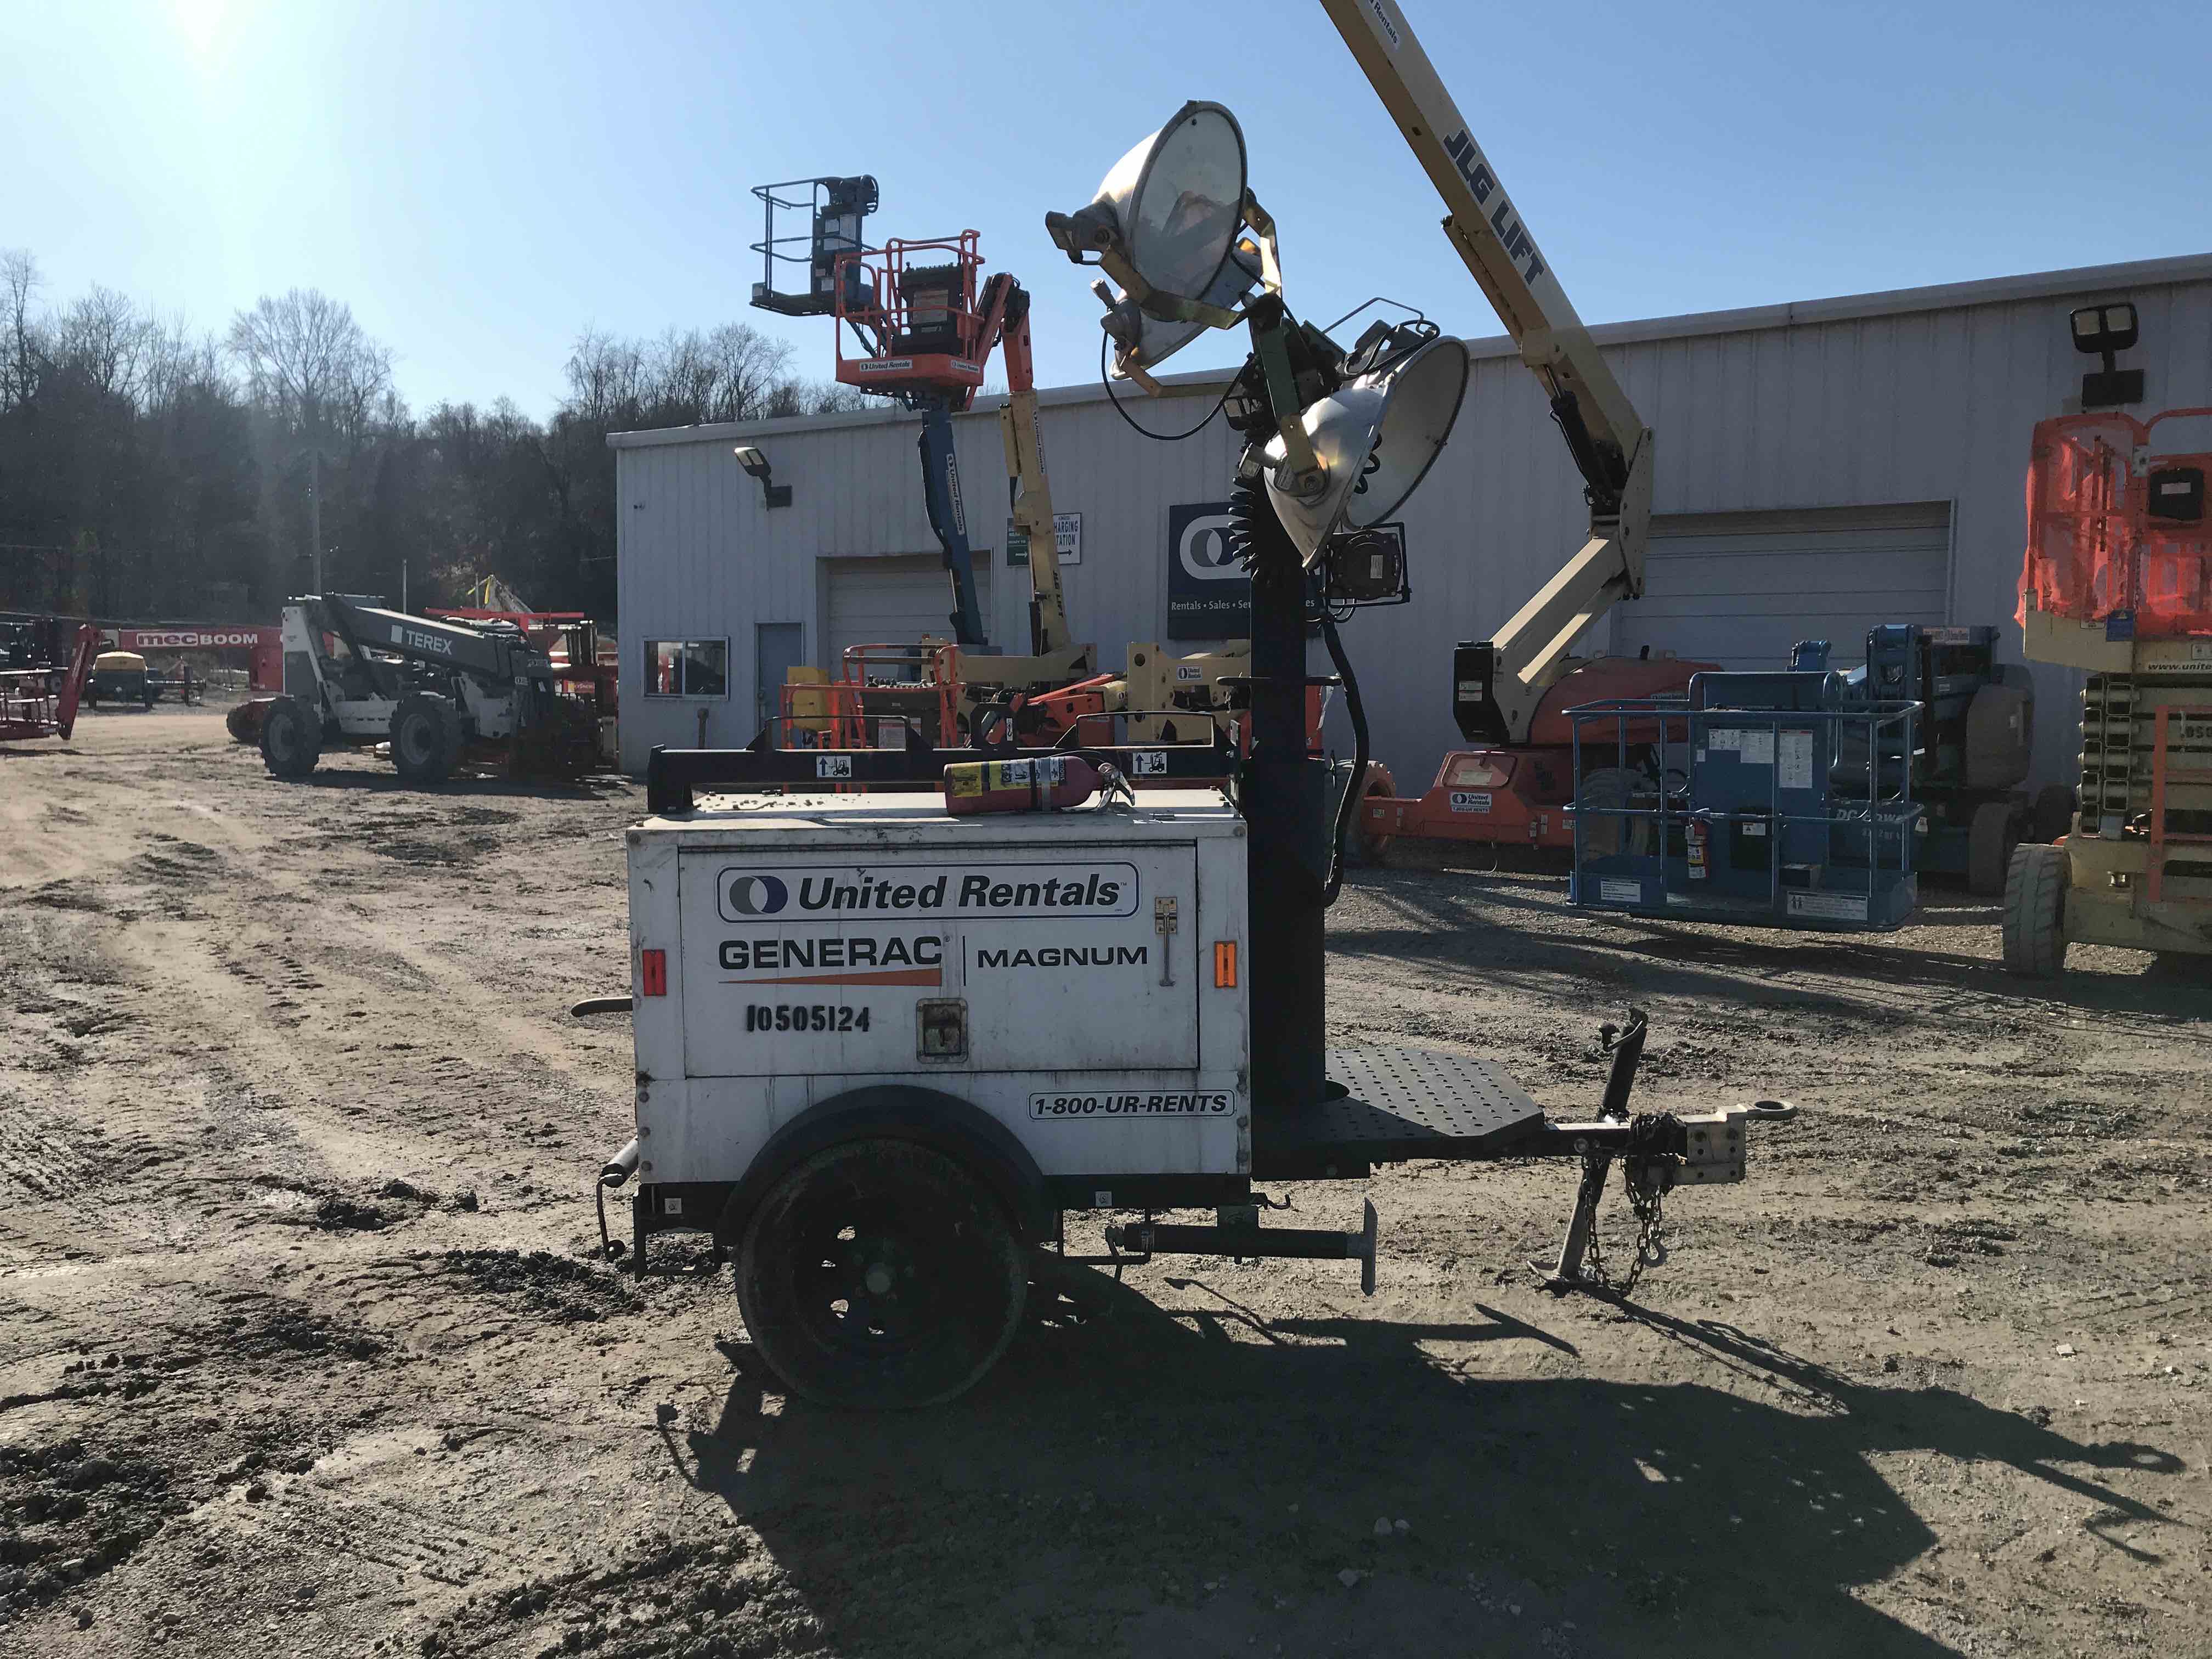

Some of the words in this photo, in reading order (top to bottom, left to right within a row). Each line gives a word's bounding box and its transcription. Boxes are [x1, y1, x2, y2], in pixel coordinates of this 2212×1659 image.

[1374, 2, 1397, 43] Rentals
[1443, 129, 1496, 205] JLG
[1491, 199, 1544, 285] LIFT
[1053, 521, 1079, 533] HARGING
[1056, 534, 1075, 546] TATION
[1171, 600, 1201, 610] Rentals
[1209, 600, 1230, 609] Sales
[407, 629, 453, 655] TEREX
[799, 877, 947, 910] United
[958, 874, 1120, 908] Rentals
[719, 936, 943, 970] GENERAC
[978, 947, 1148, 969] MAGNUM
[746, 1005, 871, 1033] 10505124
[1035, 1094, 1227, 1115] 1-800-UR-RENTS
